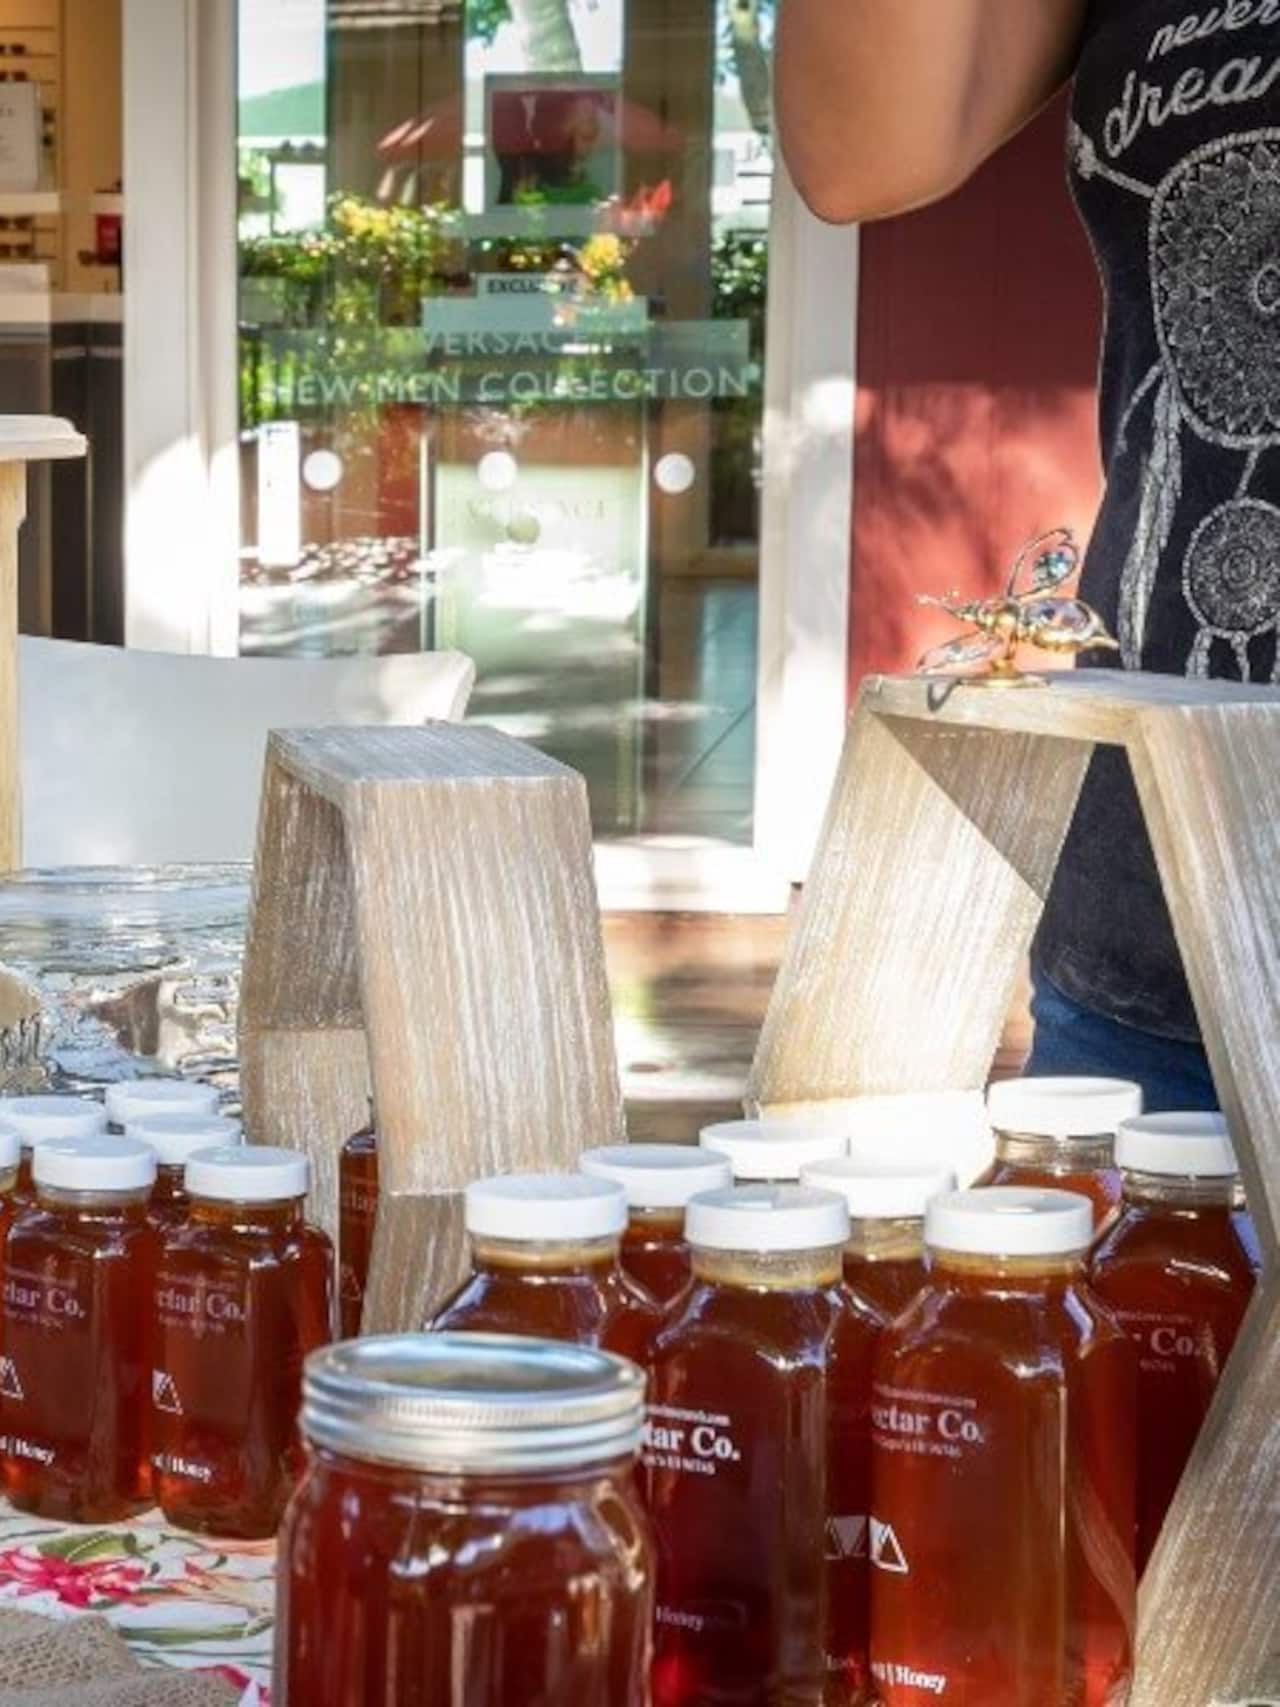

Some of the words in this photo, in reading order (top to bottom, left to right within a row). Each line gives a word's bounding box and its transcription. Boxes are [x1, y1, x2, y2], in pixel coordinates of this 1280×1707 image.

[375, 371, 460, 403] MEN
[936, 1408, 985, 1443] Co.
[690, 1425, 741, 1461] Co.
[895, 1664, 946, 1695] Honey
